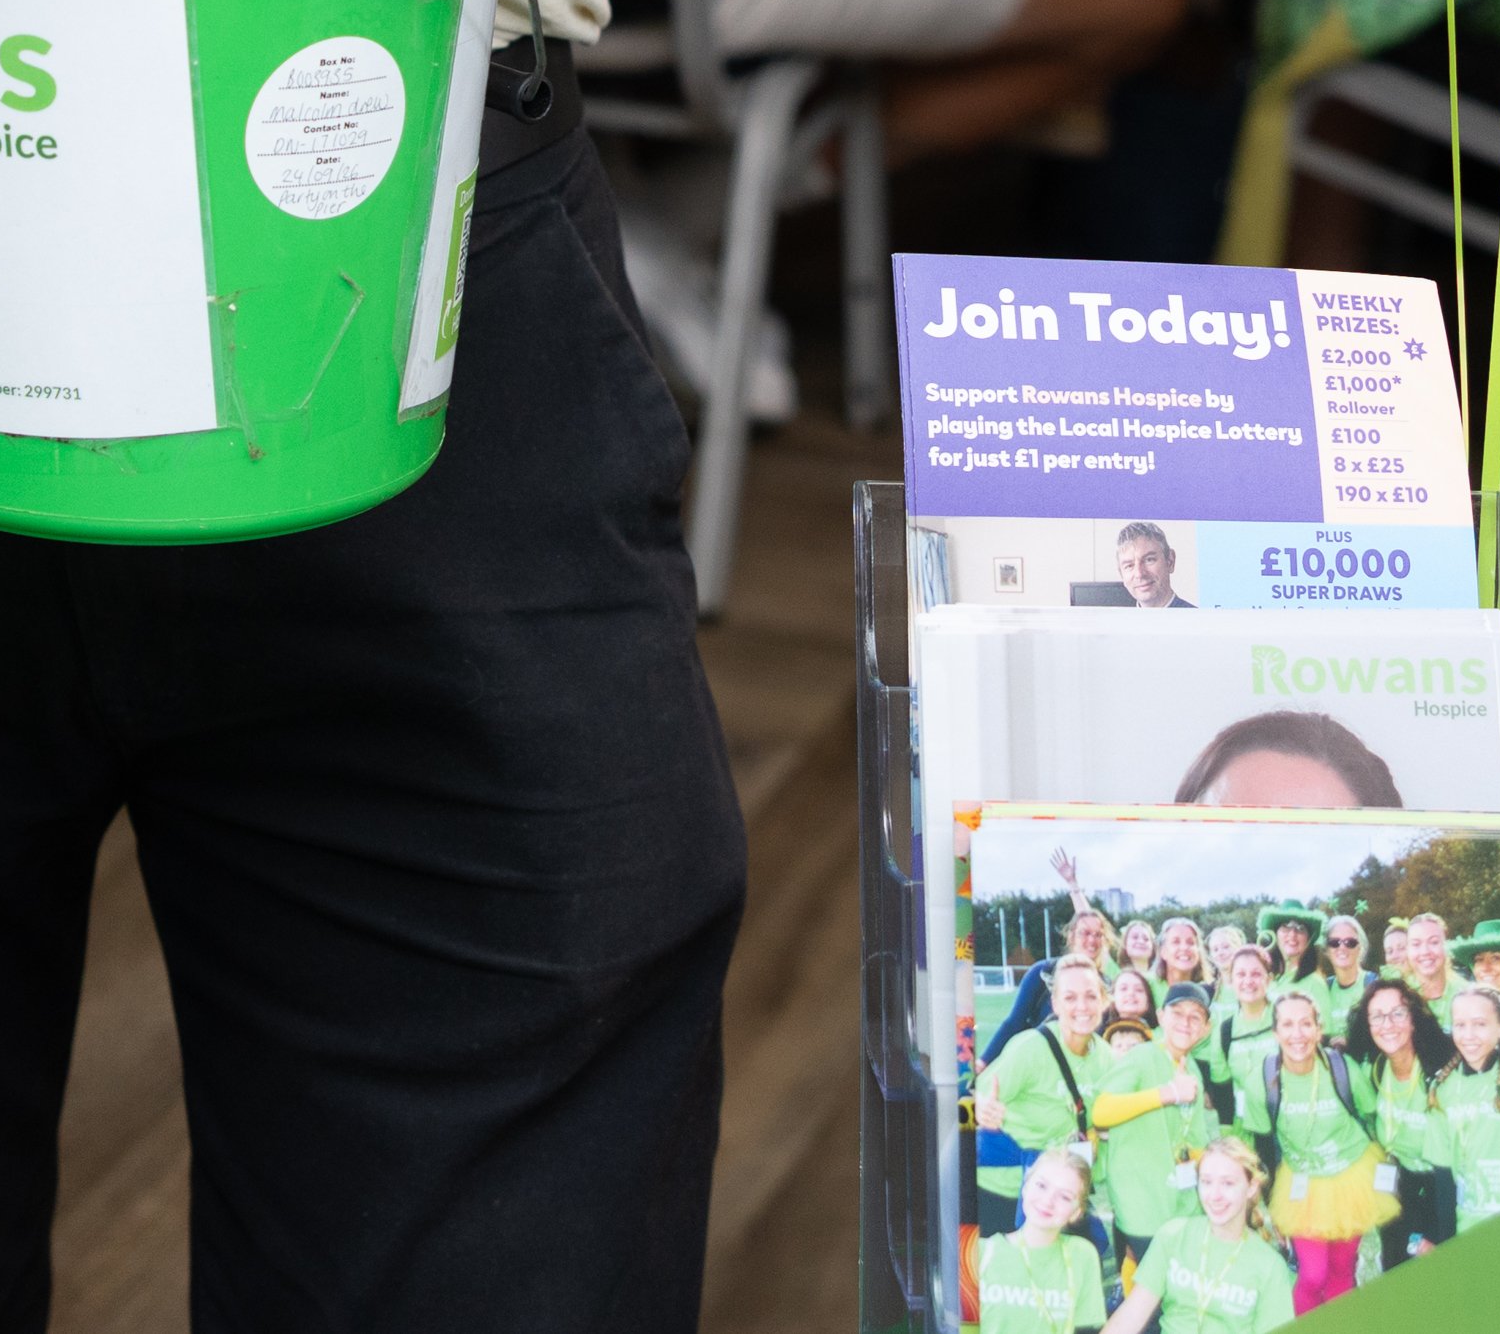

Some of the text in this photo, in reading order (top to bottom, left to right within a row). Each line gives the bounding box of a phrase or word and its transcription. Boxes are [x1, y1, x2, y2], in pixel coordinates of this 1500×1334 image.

[319, 56, 356, 67] Box No:
[319, 90, 349, 100] Name:
[303, 121, 358, 134] Contact No:
[316, 156, 341, 165] Date:
[343, 183, 367, 197] the
[313, 201, 347, 218] pier
[1312, 293, 1403, 313] WEEKLY
[923, 287, 1291, 360] Join Today!
[1316, 316, 1399, 335] PRIZES:
[1321, 349, 1391, 367] £2,000
[24, 384, 81, 401] 299731
[925, 383, 1234, 413] Support Rowans Hospice by
[1327, 401, 1396, 415] Rollover
[928, 415, 1303, 445] playing the Local Hospice Lottery
[1331, 428, 1381, 444] £100
[928, 447, 1155, 475] for just £1 per entry!
[1334, 457, 1405, 473] 8 x £25
[1335, 486, 1428, 503] 190 x £10
[1316, 531, 1352, 543] PLUS
[1260, 547, 1411, 584] £10,000
[1271, 584, 1403, 601] SUPER DRAWS
[1250, 644, 1487, 695] Rowans
[1414, 700, 1487, 720] Hospice
